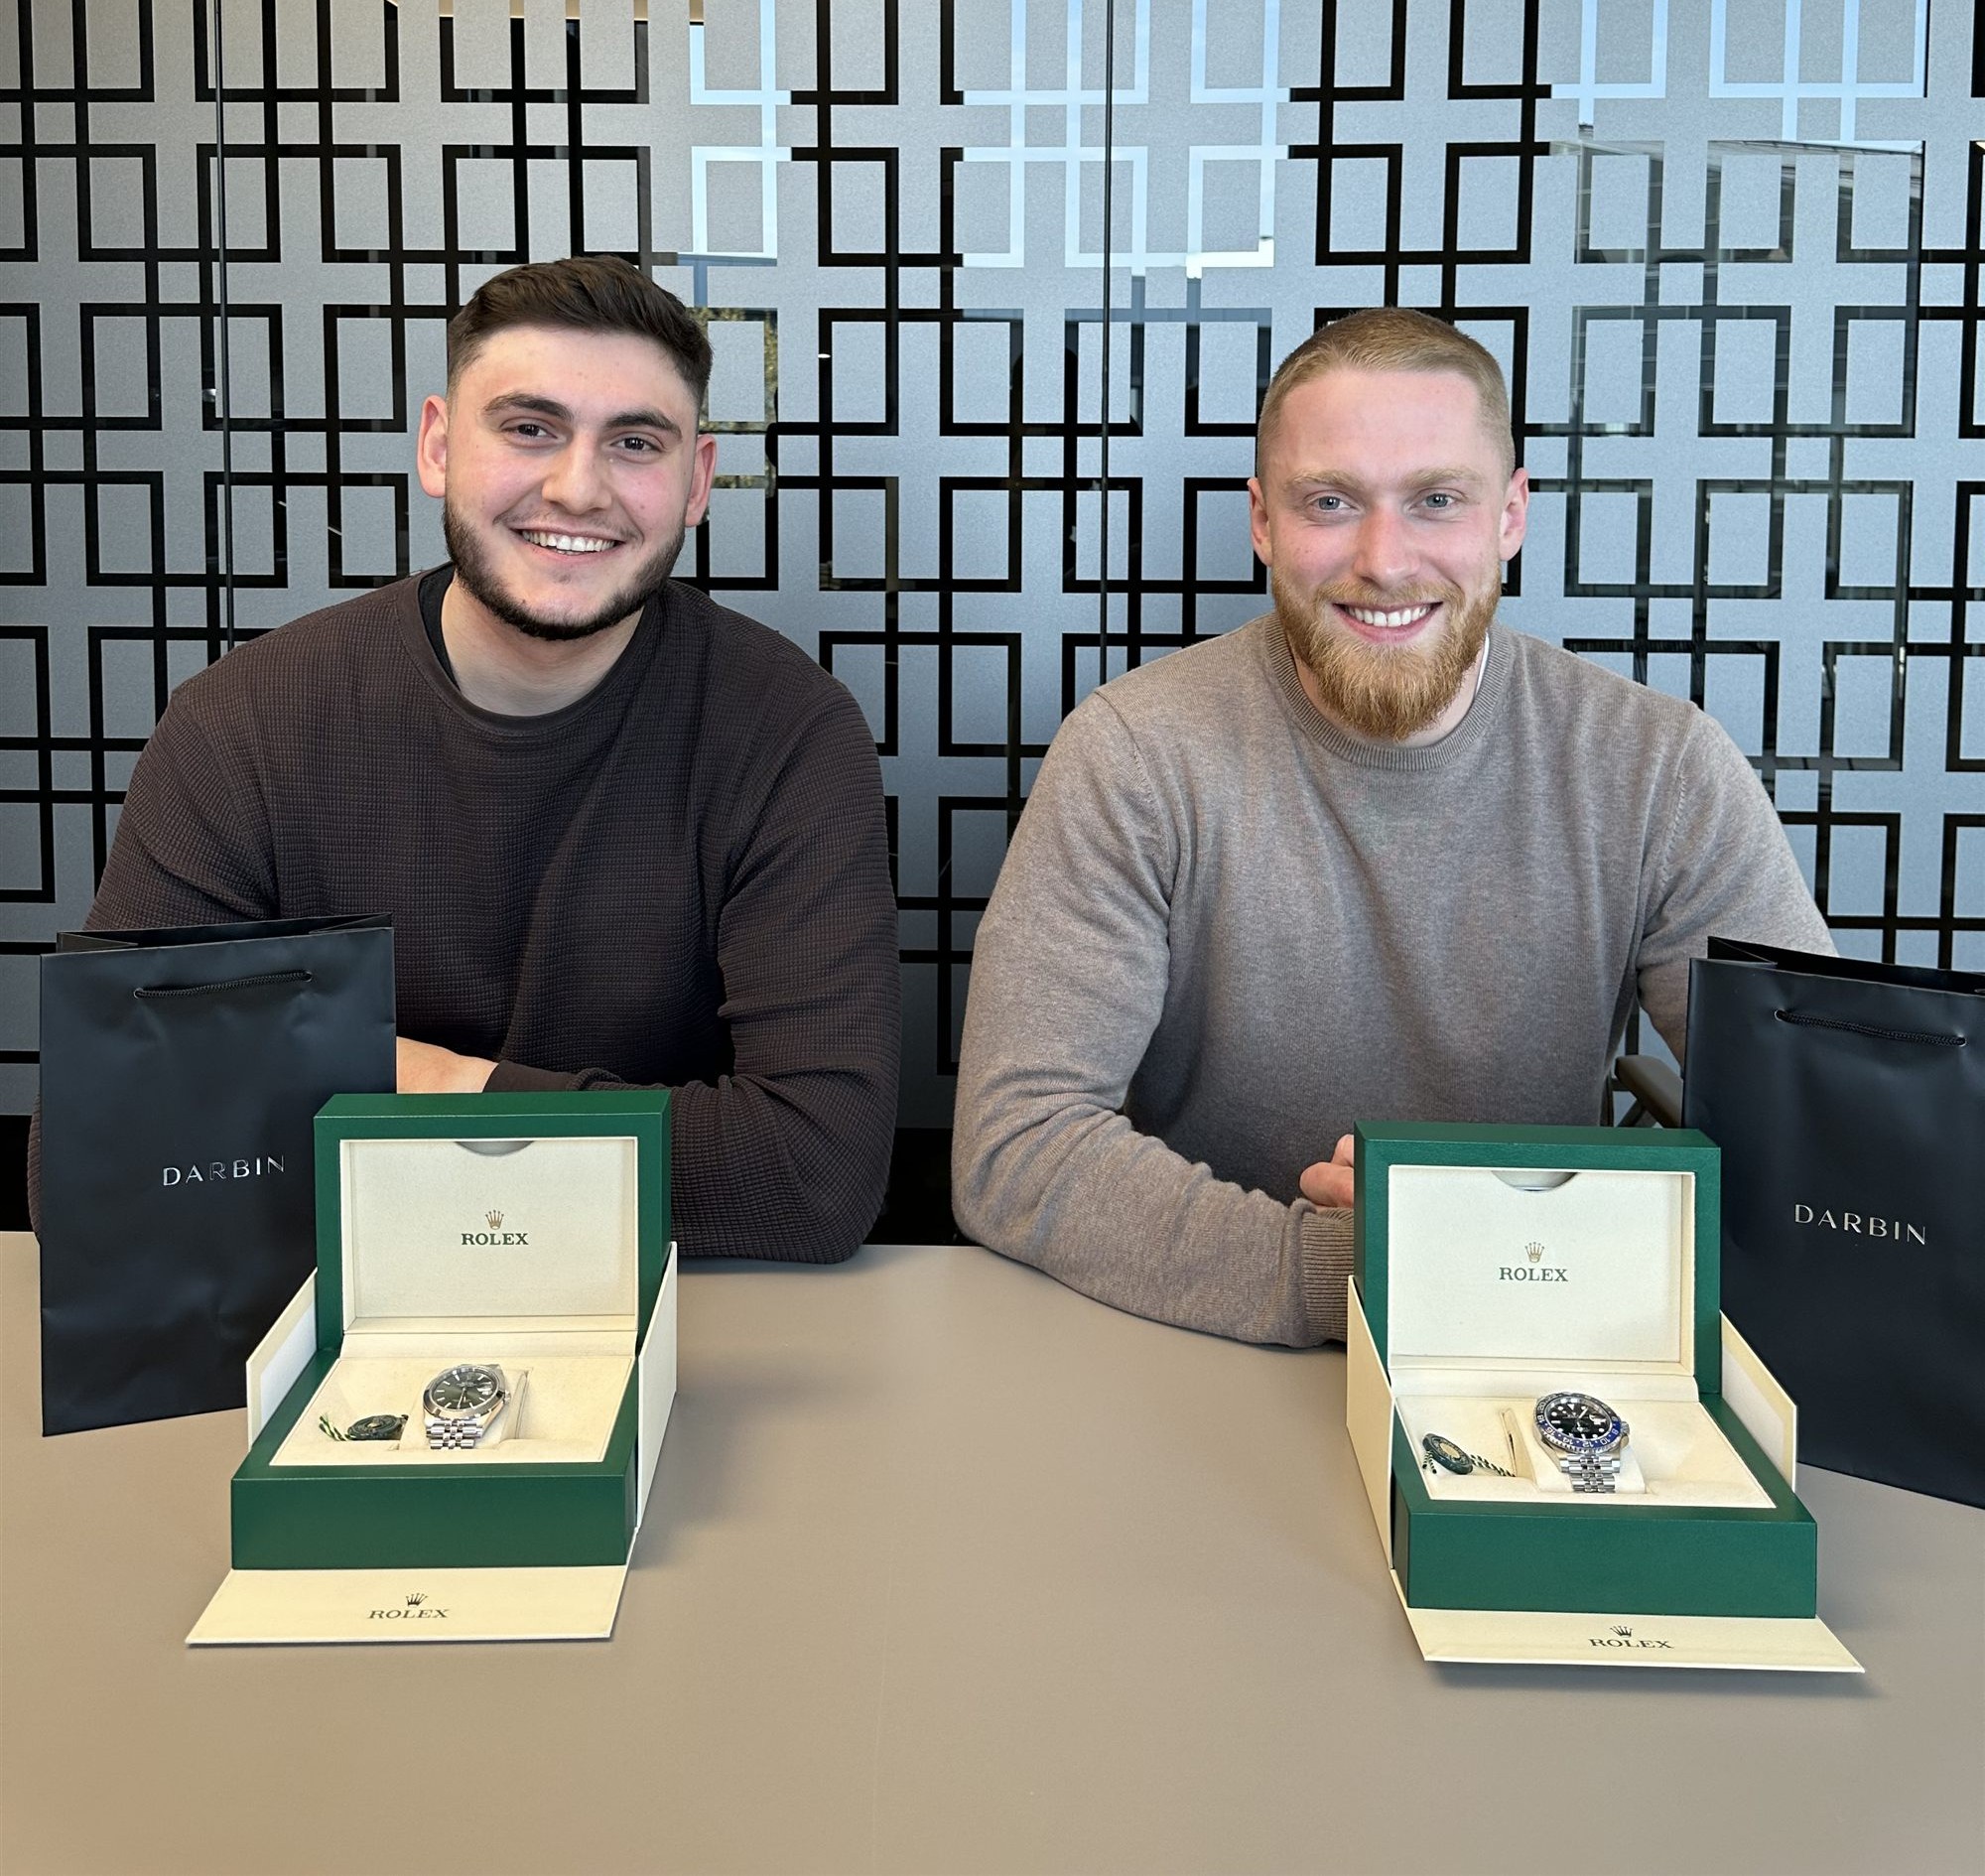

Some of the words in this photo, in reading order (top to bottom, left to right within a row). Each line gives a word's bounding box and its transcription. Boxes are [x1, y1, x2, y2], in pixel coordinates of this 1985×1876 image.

[163, 1154, 284, 1186] DARBIN
[1794, 1204, 1925, 1246] DARBIN
[461, 1233, 529, 1246] ROLEX
[1499, 1267, 1569, 1282] ROLEX
[367, 1609, 450, 1619] ROLEX
[1588, 1639, 1674, 1649] ROLEX
